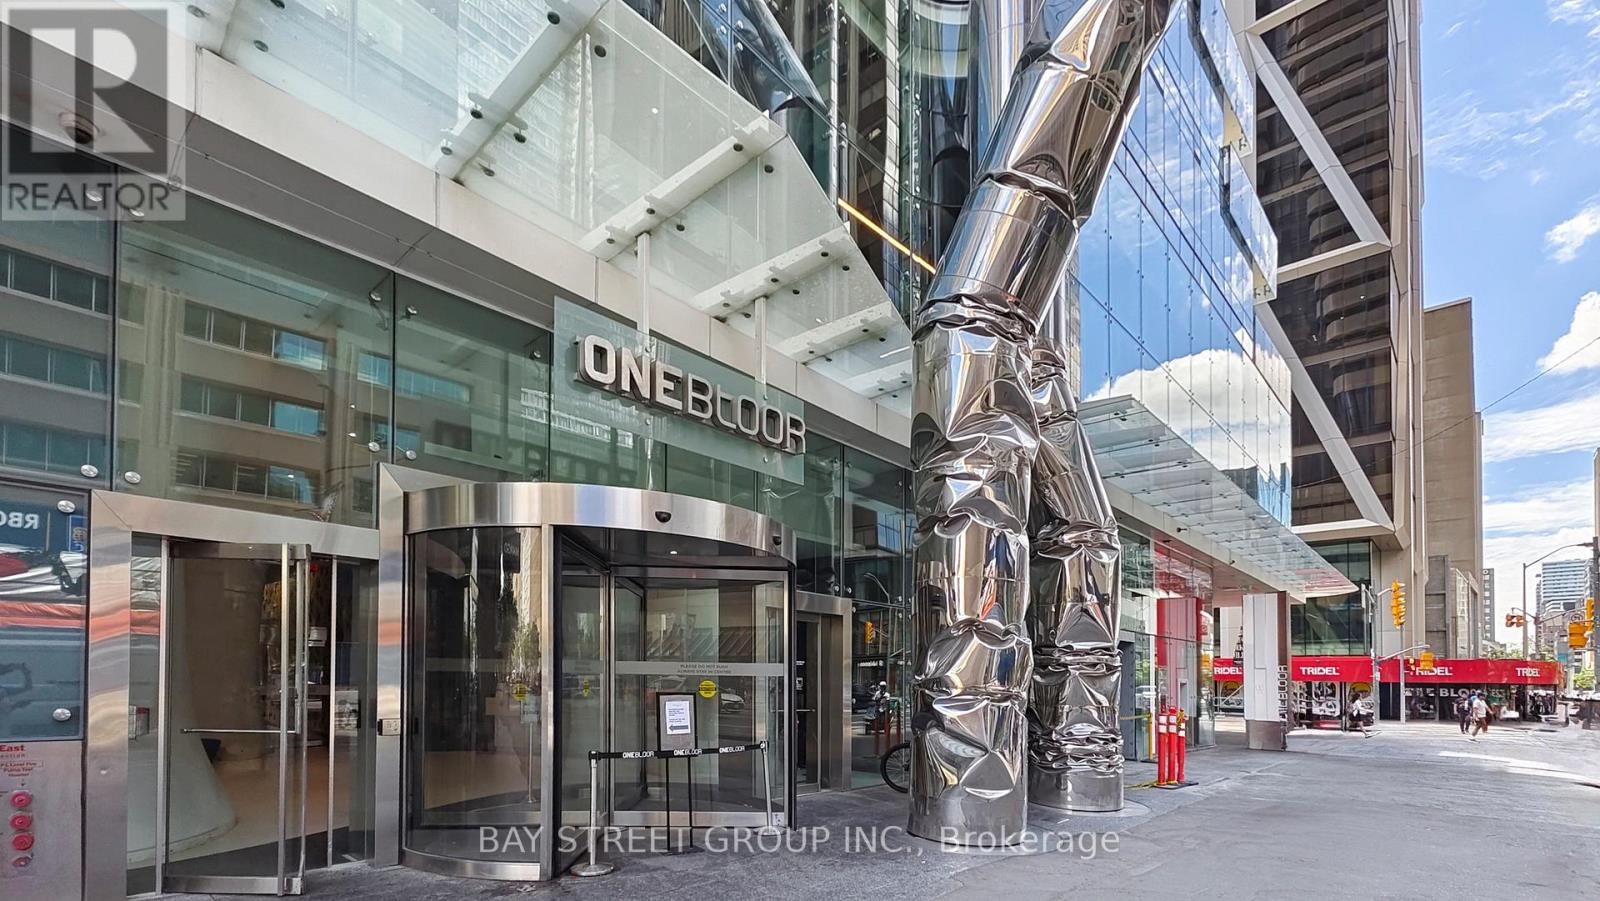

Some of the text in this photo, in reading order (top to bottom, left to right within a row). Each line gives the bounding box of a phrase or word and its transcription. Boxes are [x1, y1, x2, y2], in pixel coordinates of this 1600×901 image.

[1214, 666, 1242, 675] RIDEL
[1300, 666, 1340, 676] TRIDEL
[0, 744, 25, 752] East
[622, 751, 655, 759] ONEBLOOR
[718, 745, 746, 754] ONEBLOOR
